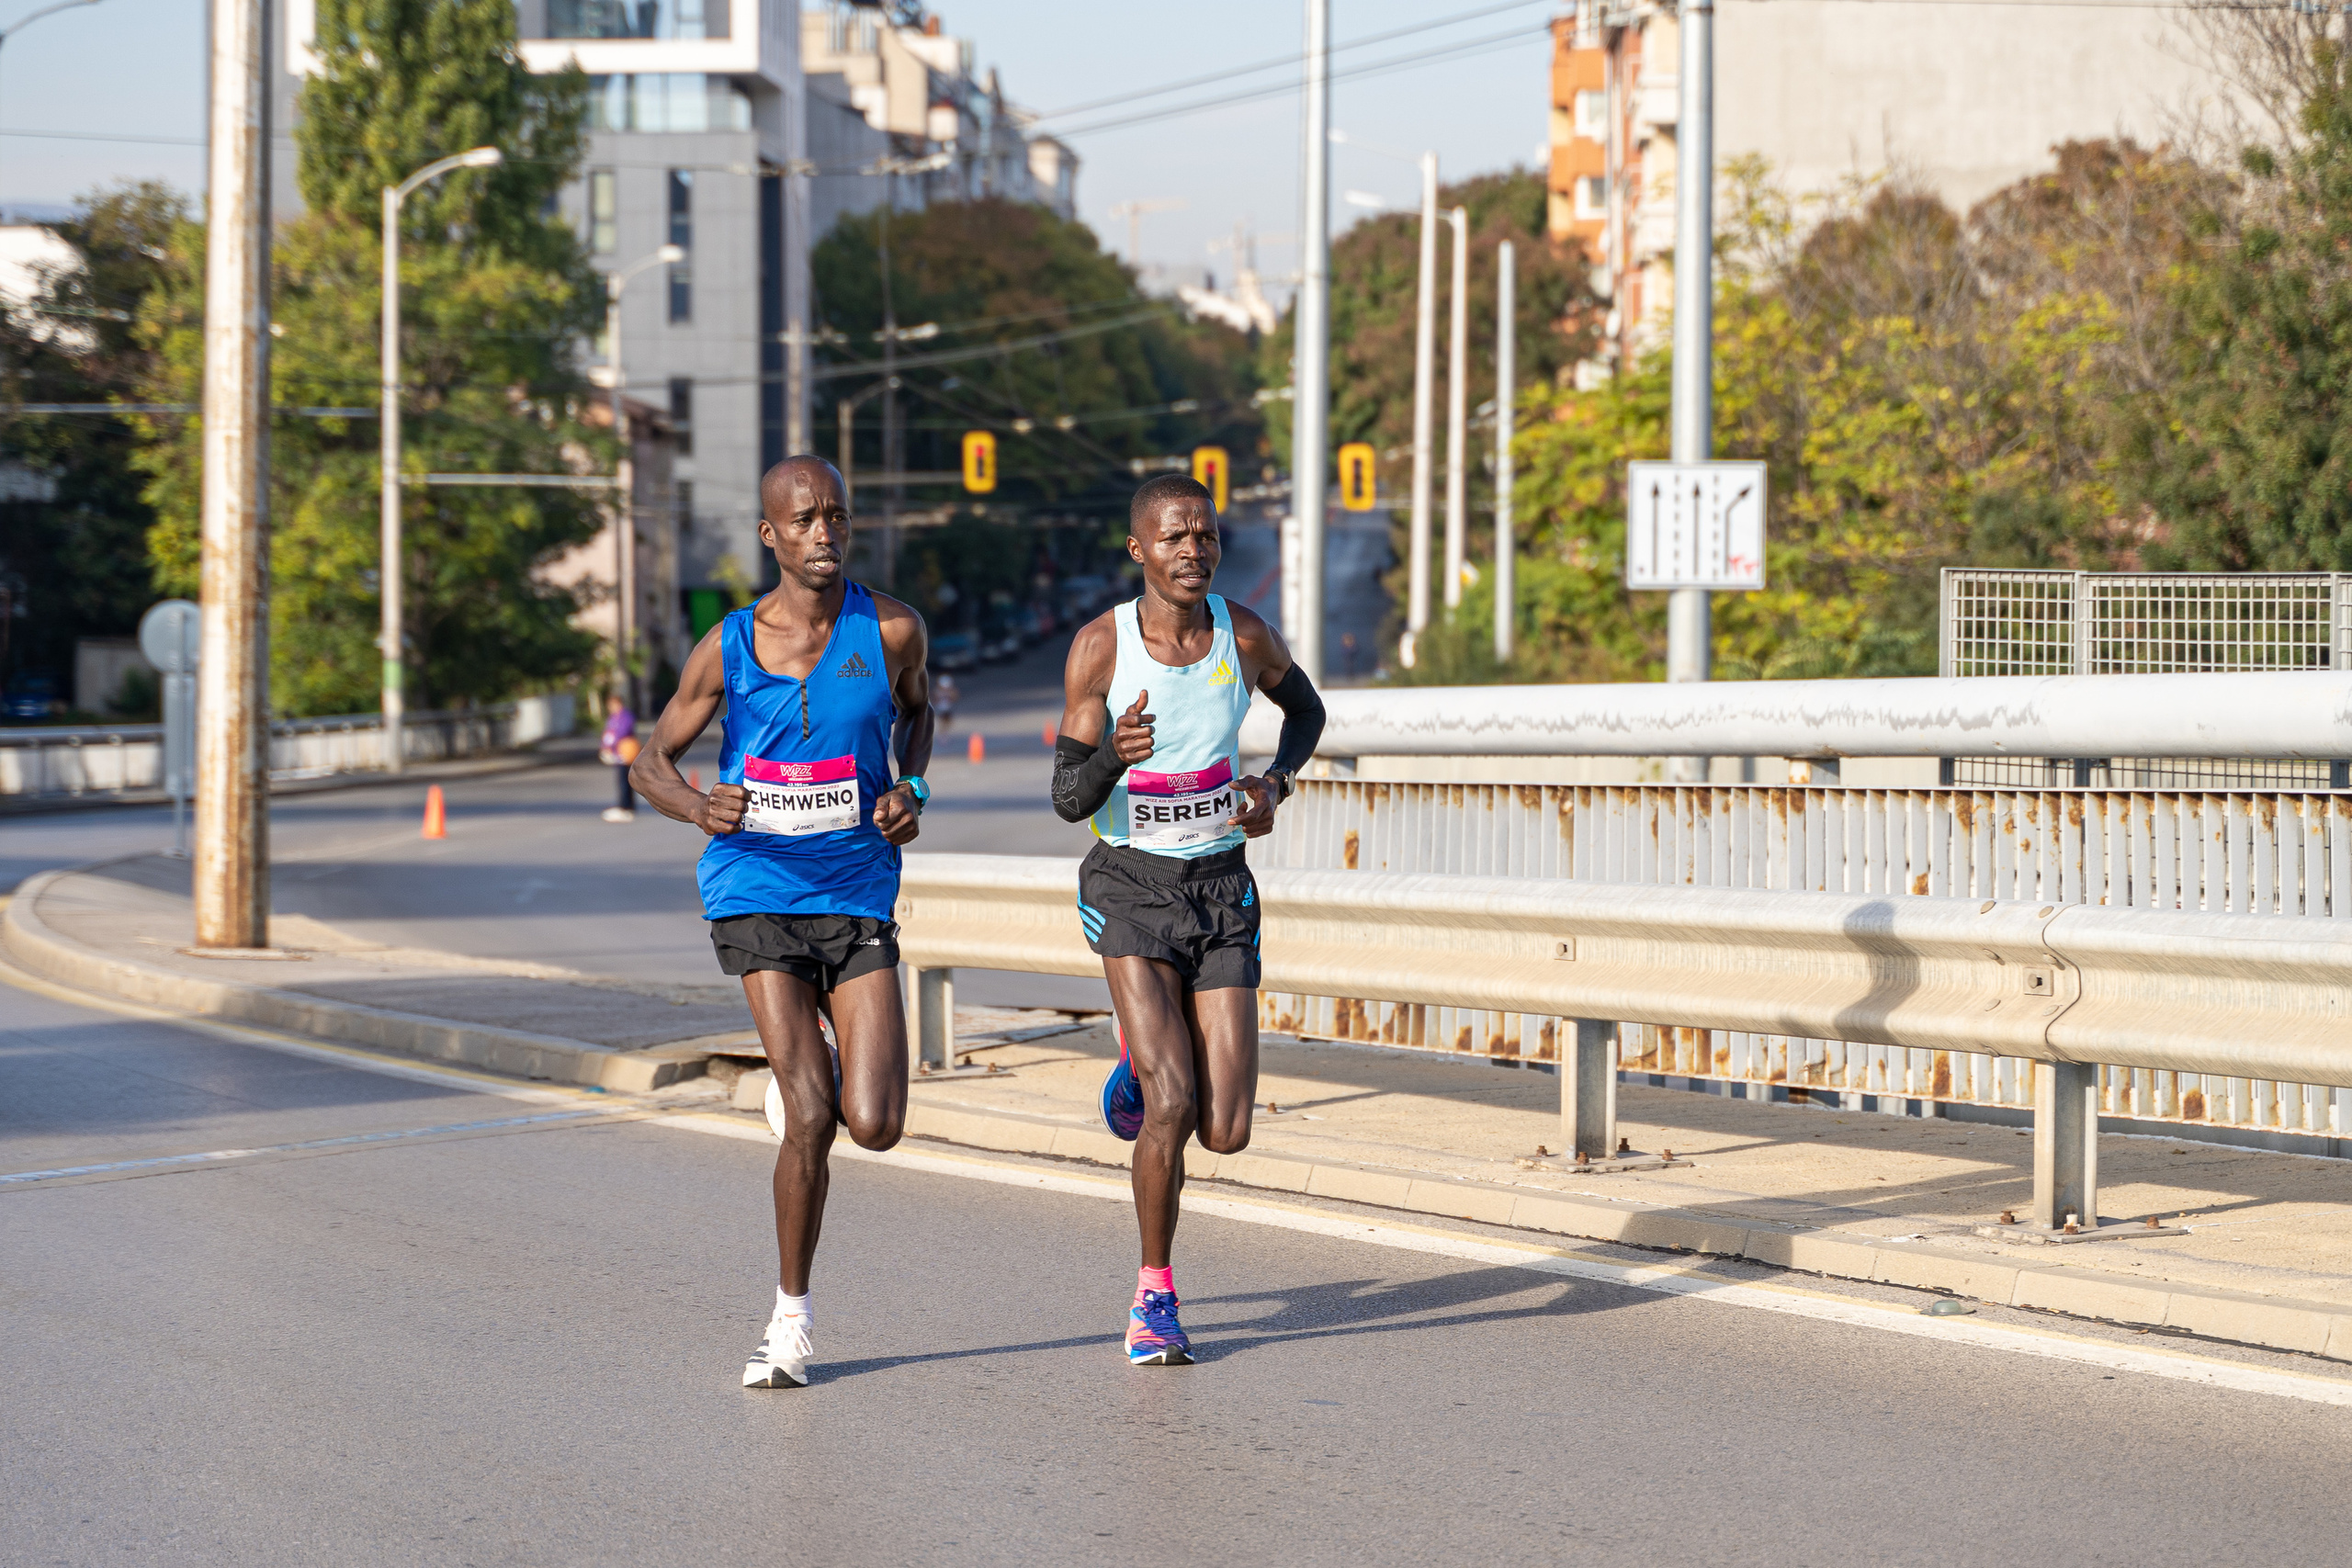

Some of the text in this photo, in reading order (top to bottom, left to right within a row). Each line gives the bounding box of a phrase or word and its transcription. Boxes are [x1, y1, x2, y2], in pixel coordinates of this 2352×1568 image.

[836, 668, 872, 678] adidas
[1208, 676, 1238, 686] adidas
[751, 789, 853, 811] CHEMWENO
[1183, 793, 1211, 801] MARATHON
[1135, 791, 1232, 822] SEREM
